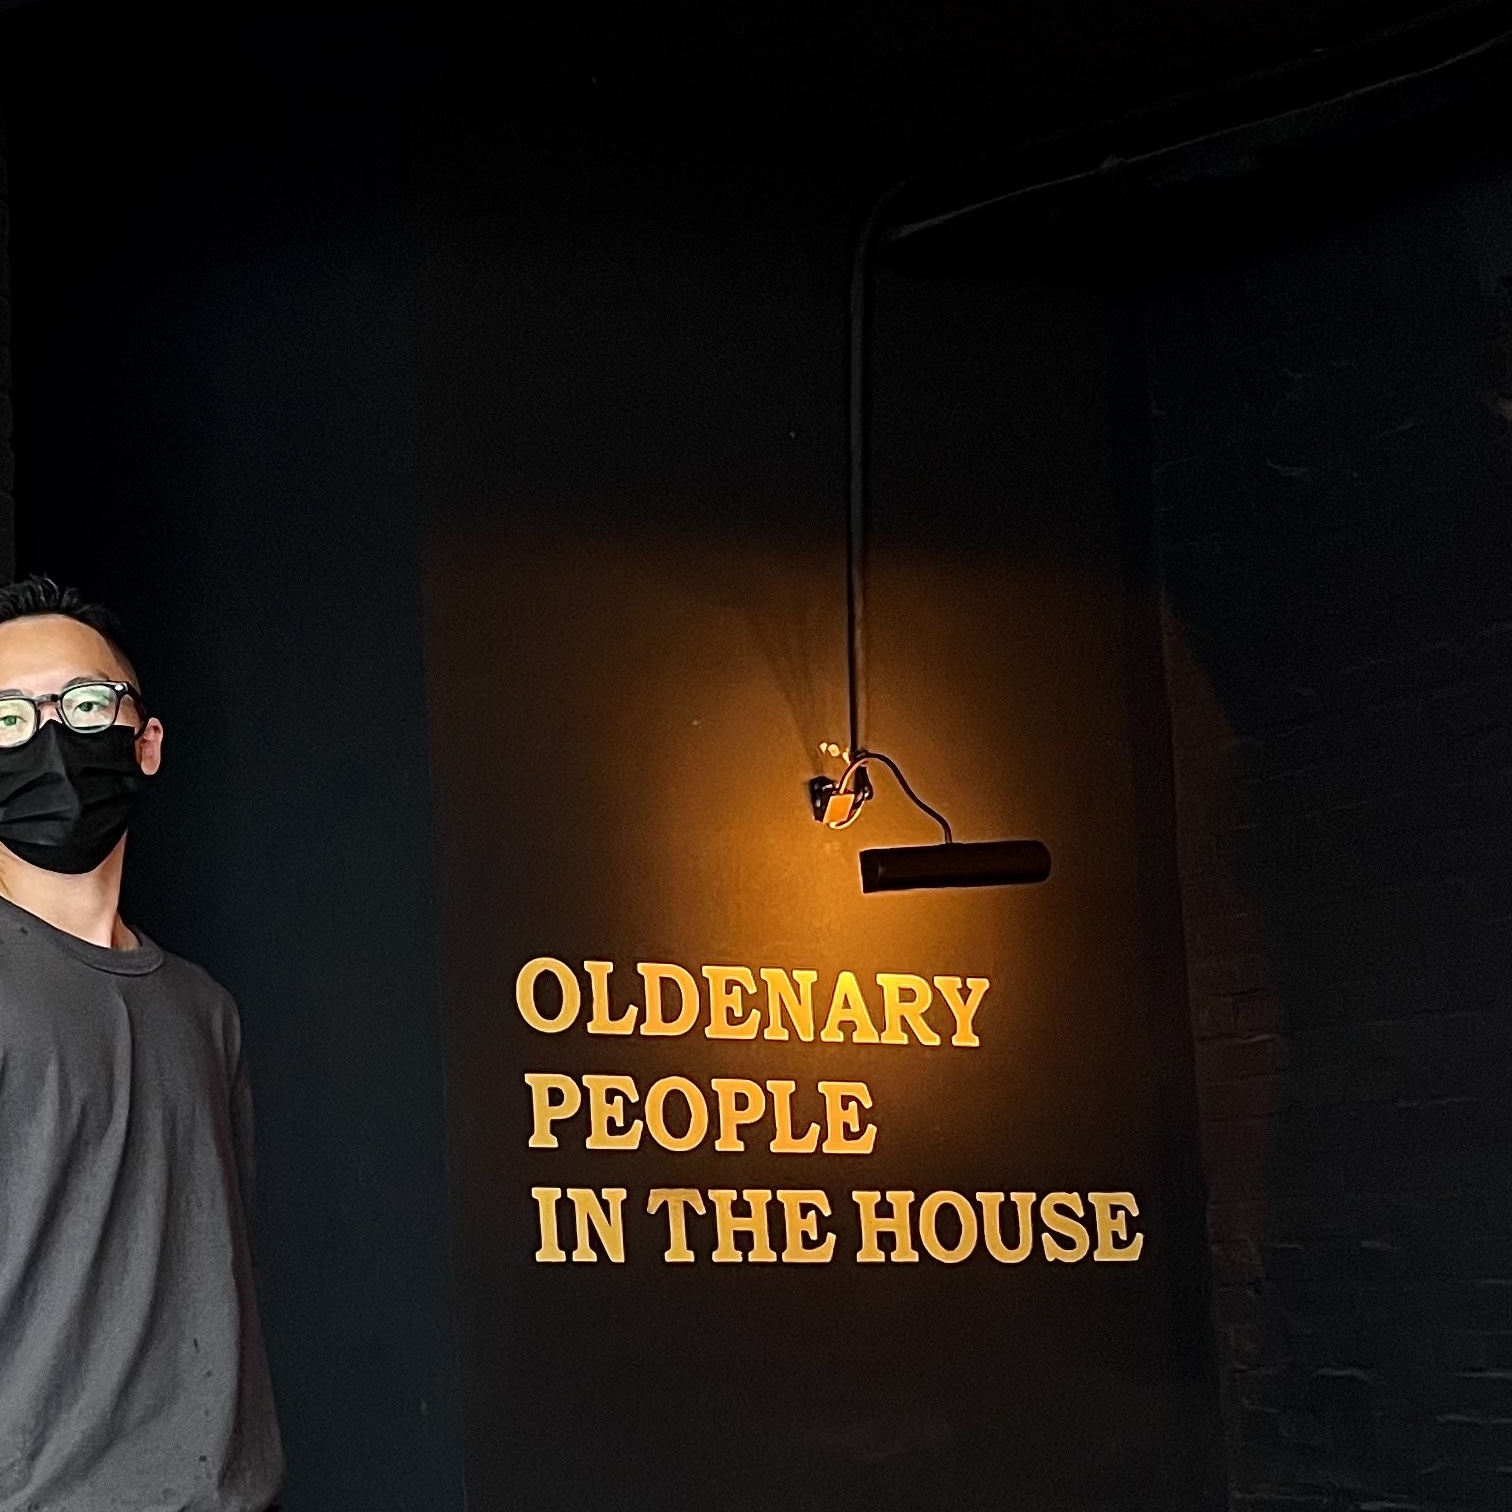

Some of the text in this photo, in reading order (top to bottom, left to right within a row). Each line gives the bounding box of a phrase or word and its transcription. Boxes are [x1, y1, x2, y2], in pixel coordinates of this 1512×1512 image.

[515, 956, 991, 1048] OLDENARY
[524, 1073, 878, 1155] PEOPLE
[531, 1186, 1144, 1264] IN THE HOUSE
